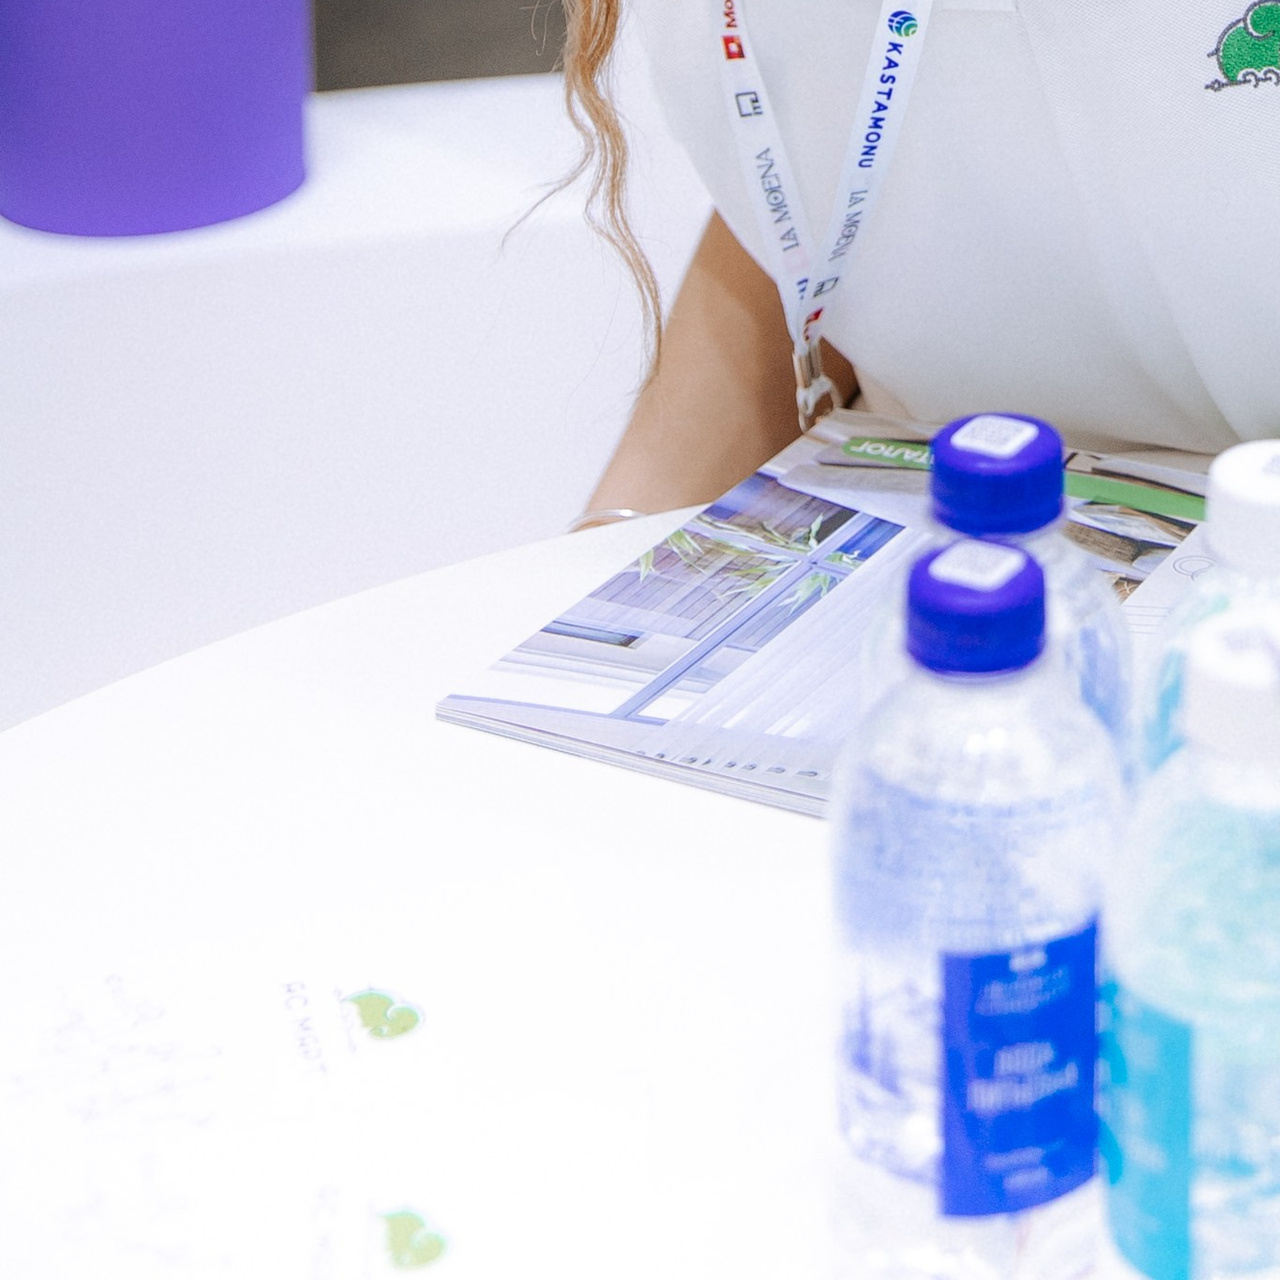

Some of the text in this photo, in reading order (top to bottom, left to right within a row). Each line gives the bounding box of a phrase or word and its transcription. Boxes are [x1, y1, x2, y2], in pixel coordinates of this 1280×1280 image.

[857, 41, 904, 169] KASTAMONU
[755, 146, 792, 225] MOENA
[849, 440, 935, 465] ТАЛОГ
